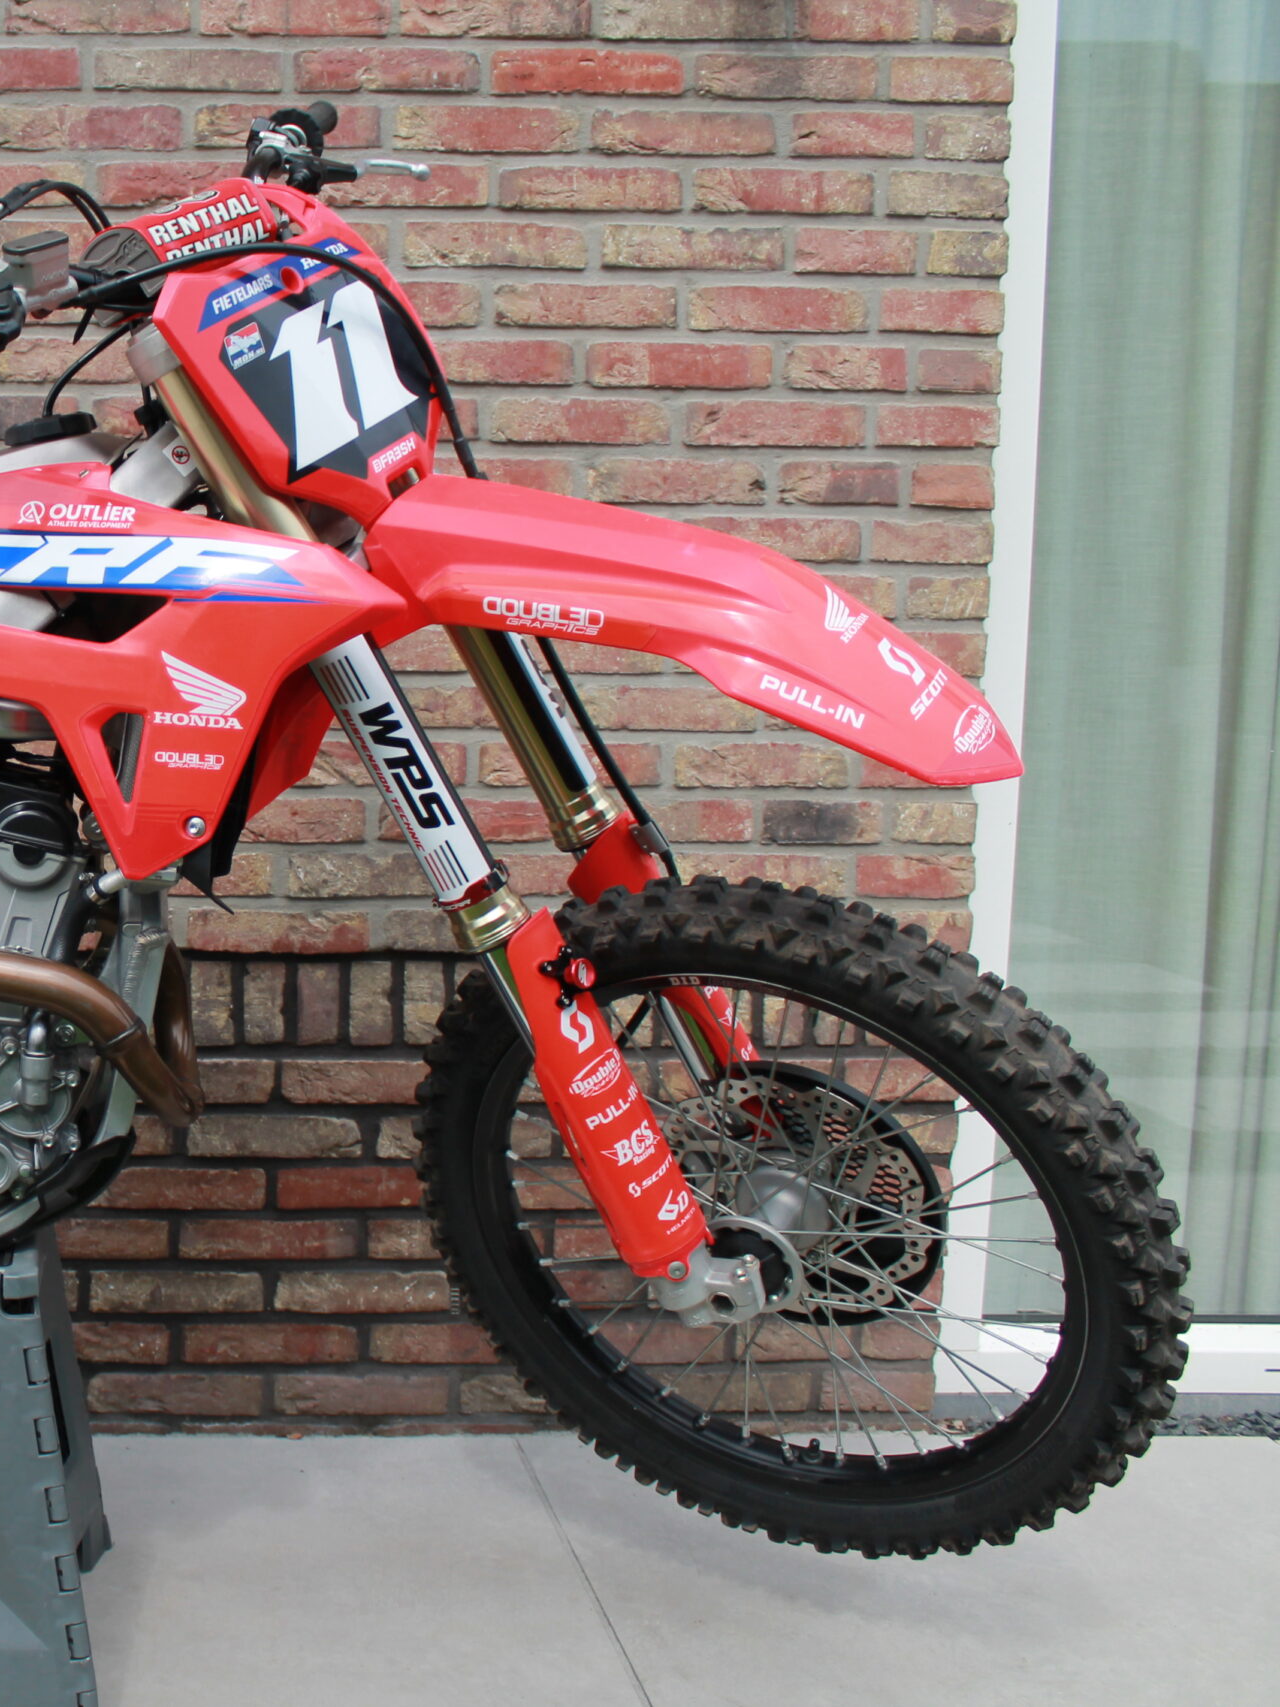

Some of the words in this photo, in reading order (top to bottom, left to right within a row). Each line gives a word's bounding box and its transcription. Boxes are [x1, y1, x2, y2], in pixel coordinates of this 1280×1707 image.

[147, 193, 260, 246] RENTHAL
[212, 274, 273, 315] FIETELAARS
[269, 279, 420, 472] 11
[47, 520, 78, 528] ATHLETE
[78, 521, 132, 529] DEVELOPMENT
[49, 501, 136, 522] OUTLIER
[506, 617, 600, 636] GRAPHICS
[839, 612, 869, 644] HONDA
[760, 674, 865, 729] PULL-IN
[910, 668, 949, 721] SCOTT
[153, 711, 244, 730] HONDA
[340, 709, 393, 794] SUSPENSION
[392, 797, 426, 852] TECHNIC
[358, 701, 456, 830] WPS
[585, 1081, 639, 1130] PULL-IN
[613, 1119, 654, 1166] BCS
[641, 1153, 672, 1190] SCOTT
